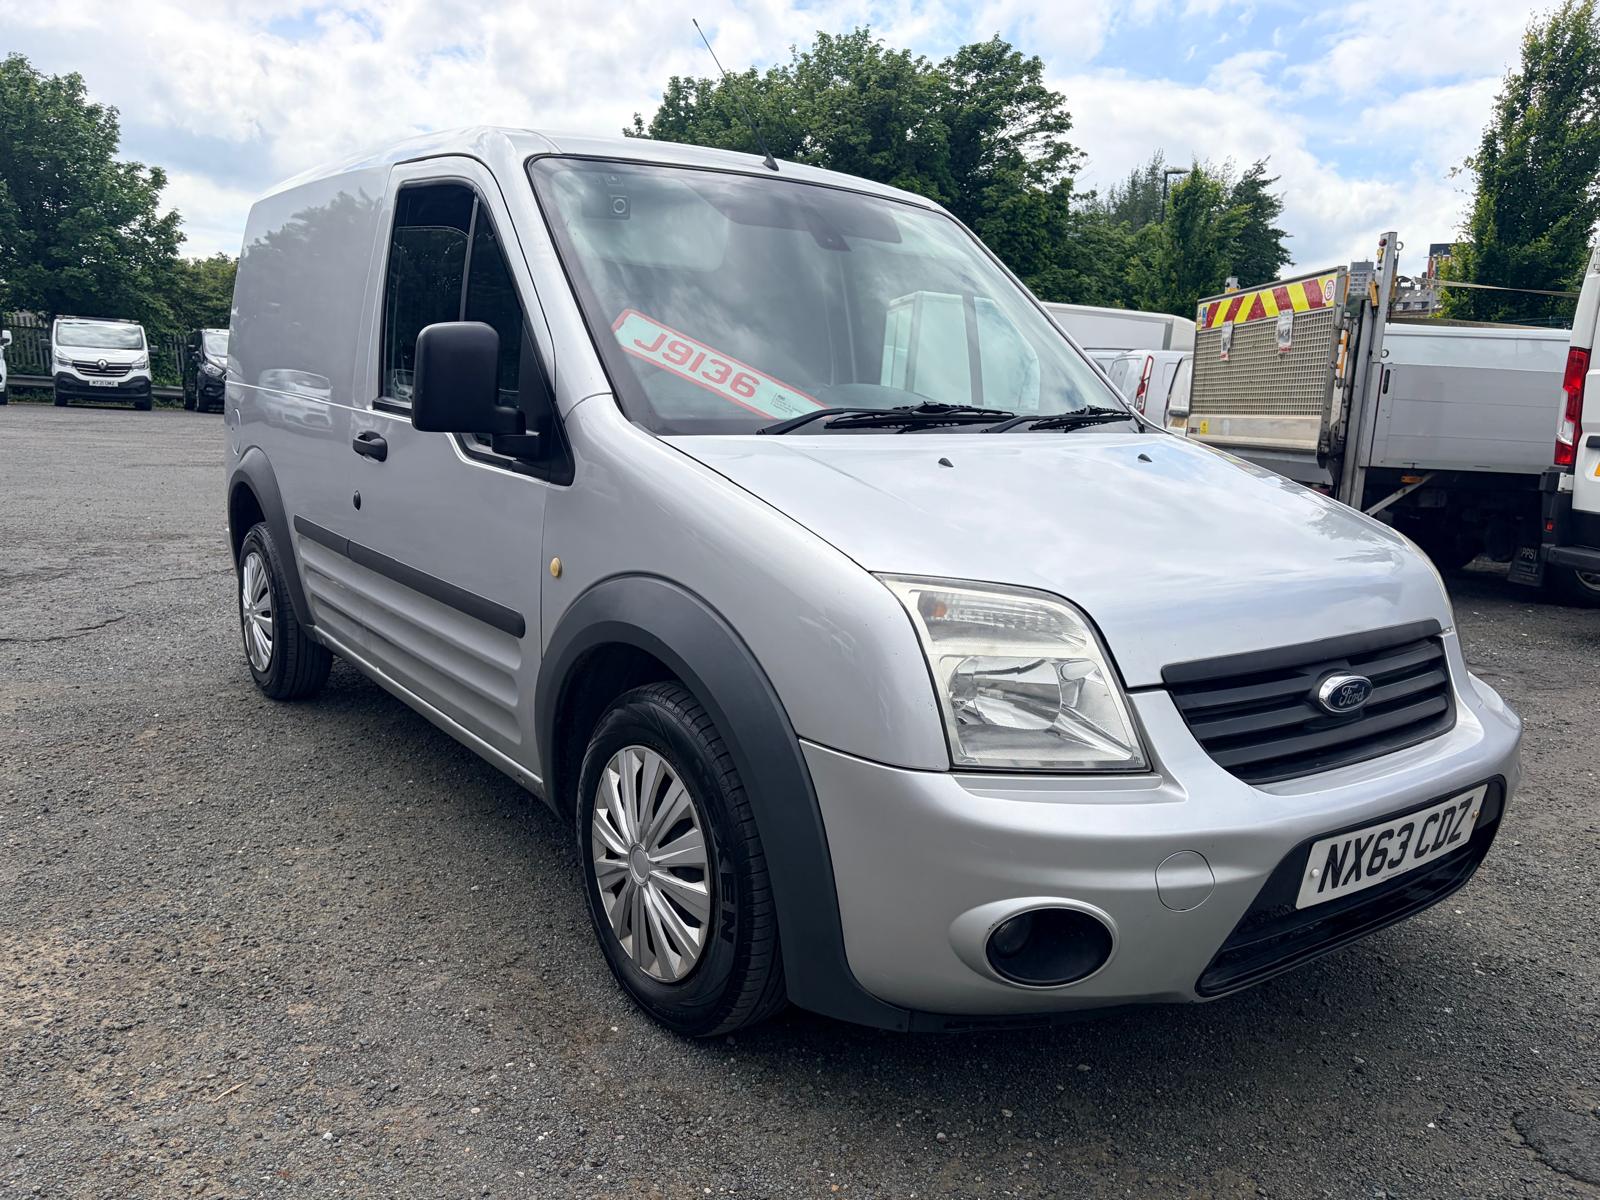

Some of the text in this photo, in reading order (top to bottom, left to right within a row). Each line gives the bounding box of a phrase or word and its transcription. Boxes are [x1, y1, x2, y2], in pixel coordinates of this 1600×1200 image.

[633, 333, 760, 398] J9136
[1339, 684, 1365, 706] Ford
[1317, 797, 1474, 893] NX63 CDZ
